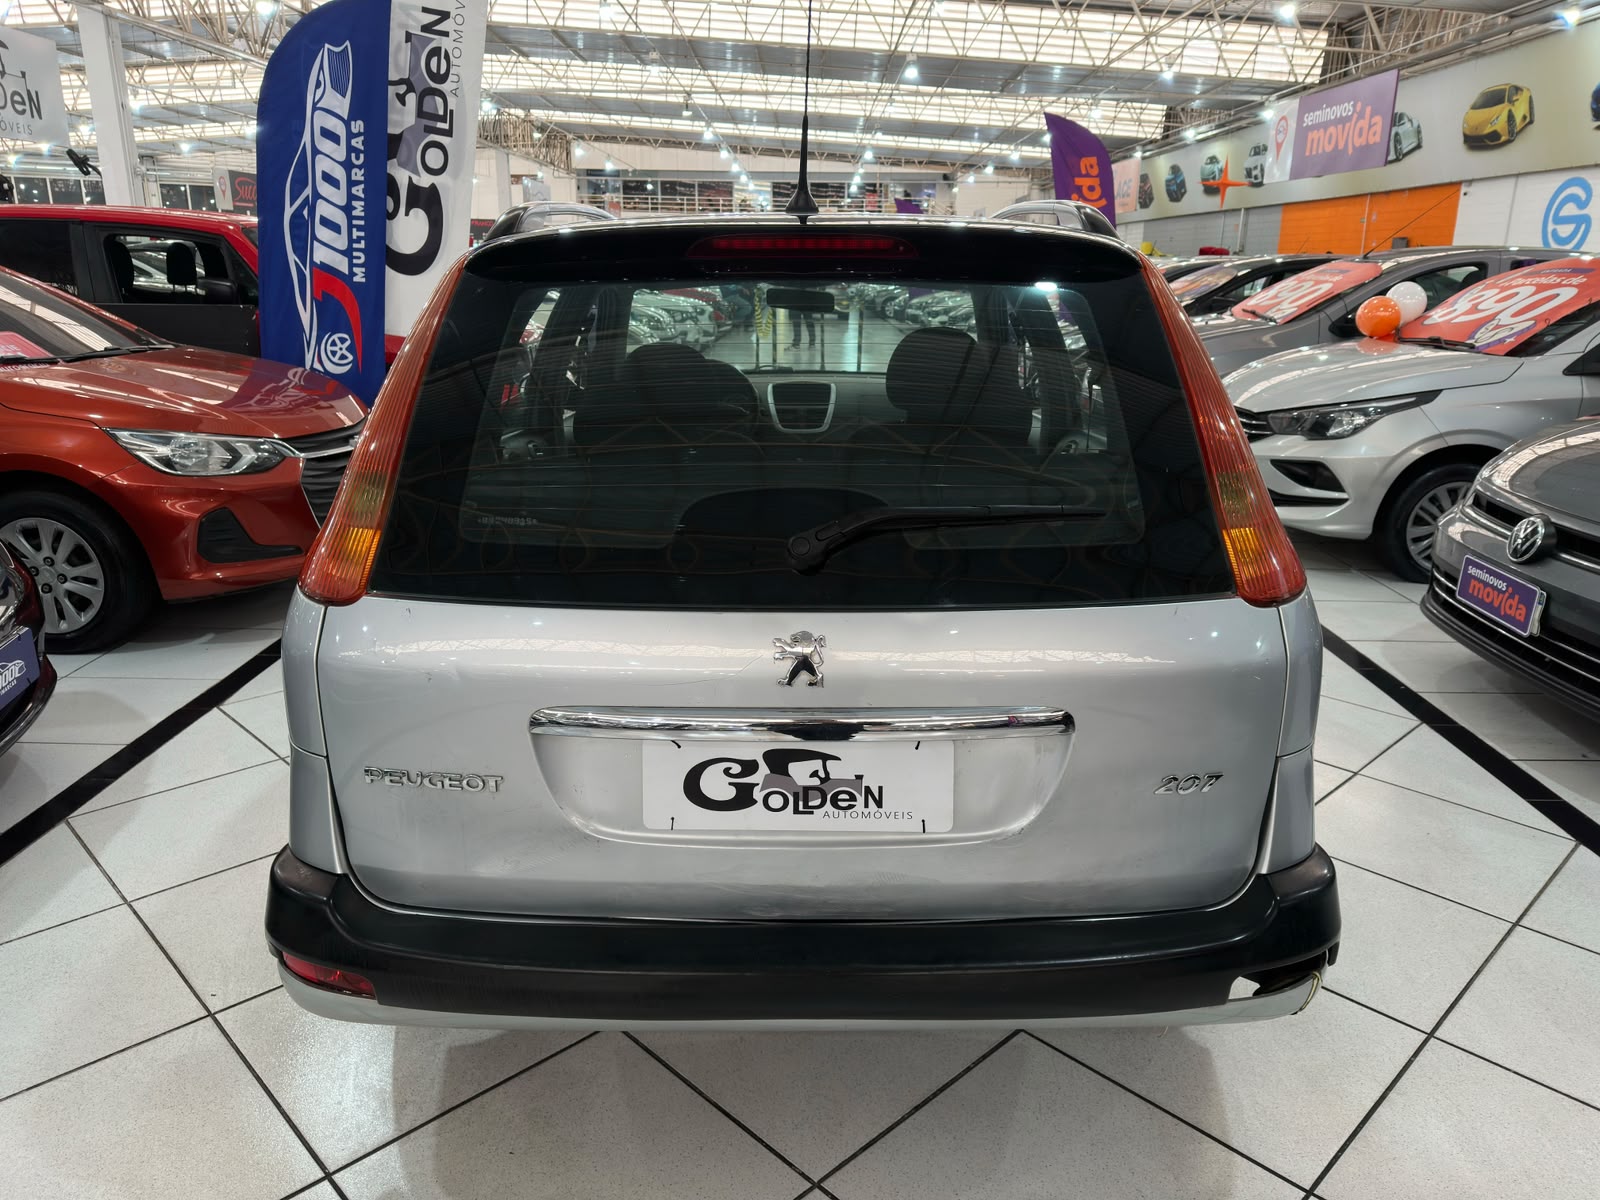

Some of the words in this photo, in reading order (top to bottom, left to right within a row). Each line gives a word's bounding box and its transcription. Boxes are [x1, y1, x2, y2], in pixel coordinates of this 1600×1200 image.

[1303, 101, 1355, 127] seminovos
[1305, 101, 1383, 156] movida
[350, 118, 366, 284] MULTIMARCAS
[1467, 564, 1507, 591] seminovos
[1468, 578, 1527, 623] movida
[364, 766, 504, 794] PEUGEOT
[1152, 772, 1224, 796] 207
[822, 808, 913, 821] AUTOMÓVEIS
